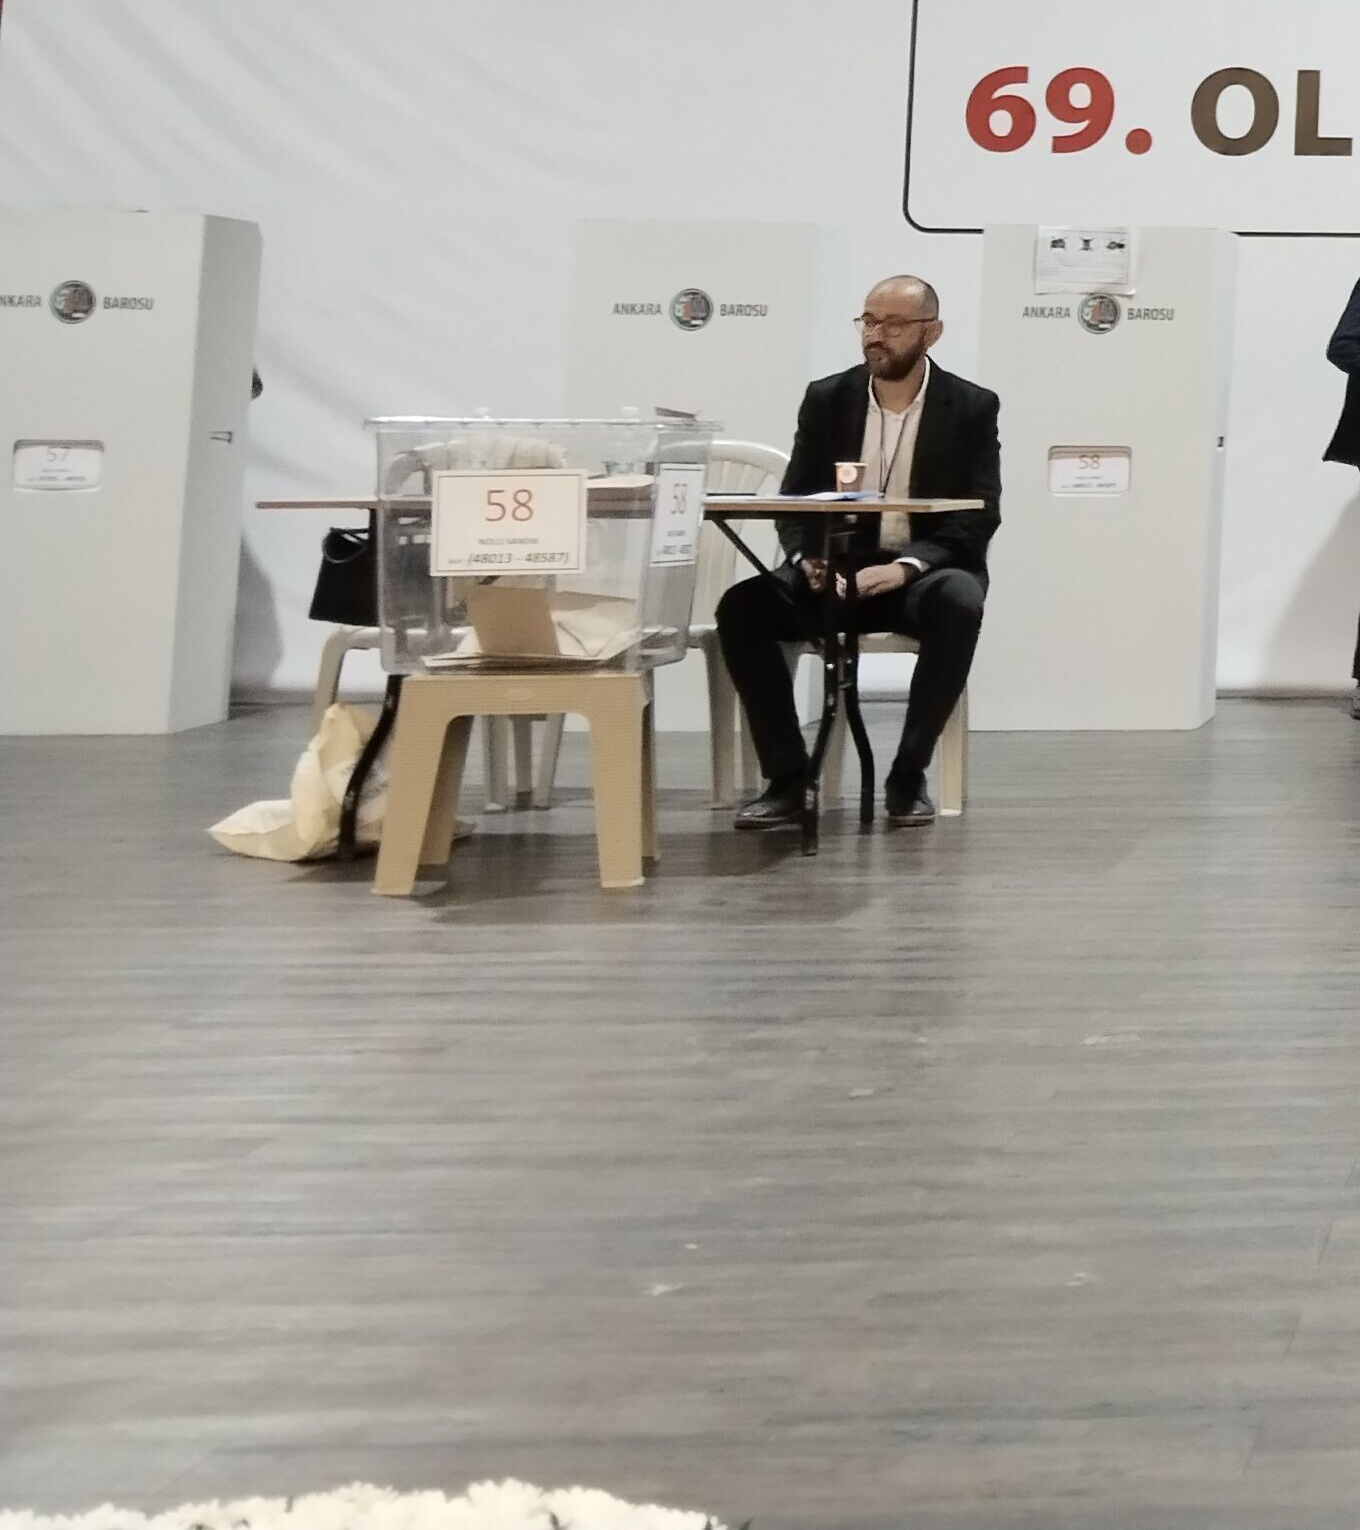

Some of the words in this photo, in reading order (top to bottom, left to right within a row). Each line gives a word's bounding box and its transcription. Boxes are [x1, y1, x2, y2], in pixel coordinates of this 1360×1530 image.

[965, 66, 1152, 155] 69.
[0, 294, 42, 308] NKARA
[103, 297, 154, 310] BAROSU
[613, 303, 662, 316] ANKARA
[720, 303, 768, 317] BAROSU
[1023, 306, 1070, 319] ANKARA
[1127, 308, 1175, 320] BAROSU
[1079, 455, 1100, 469] 58
[486, 489, 533, 522] 58
